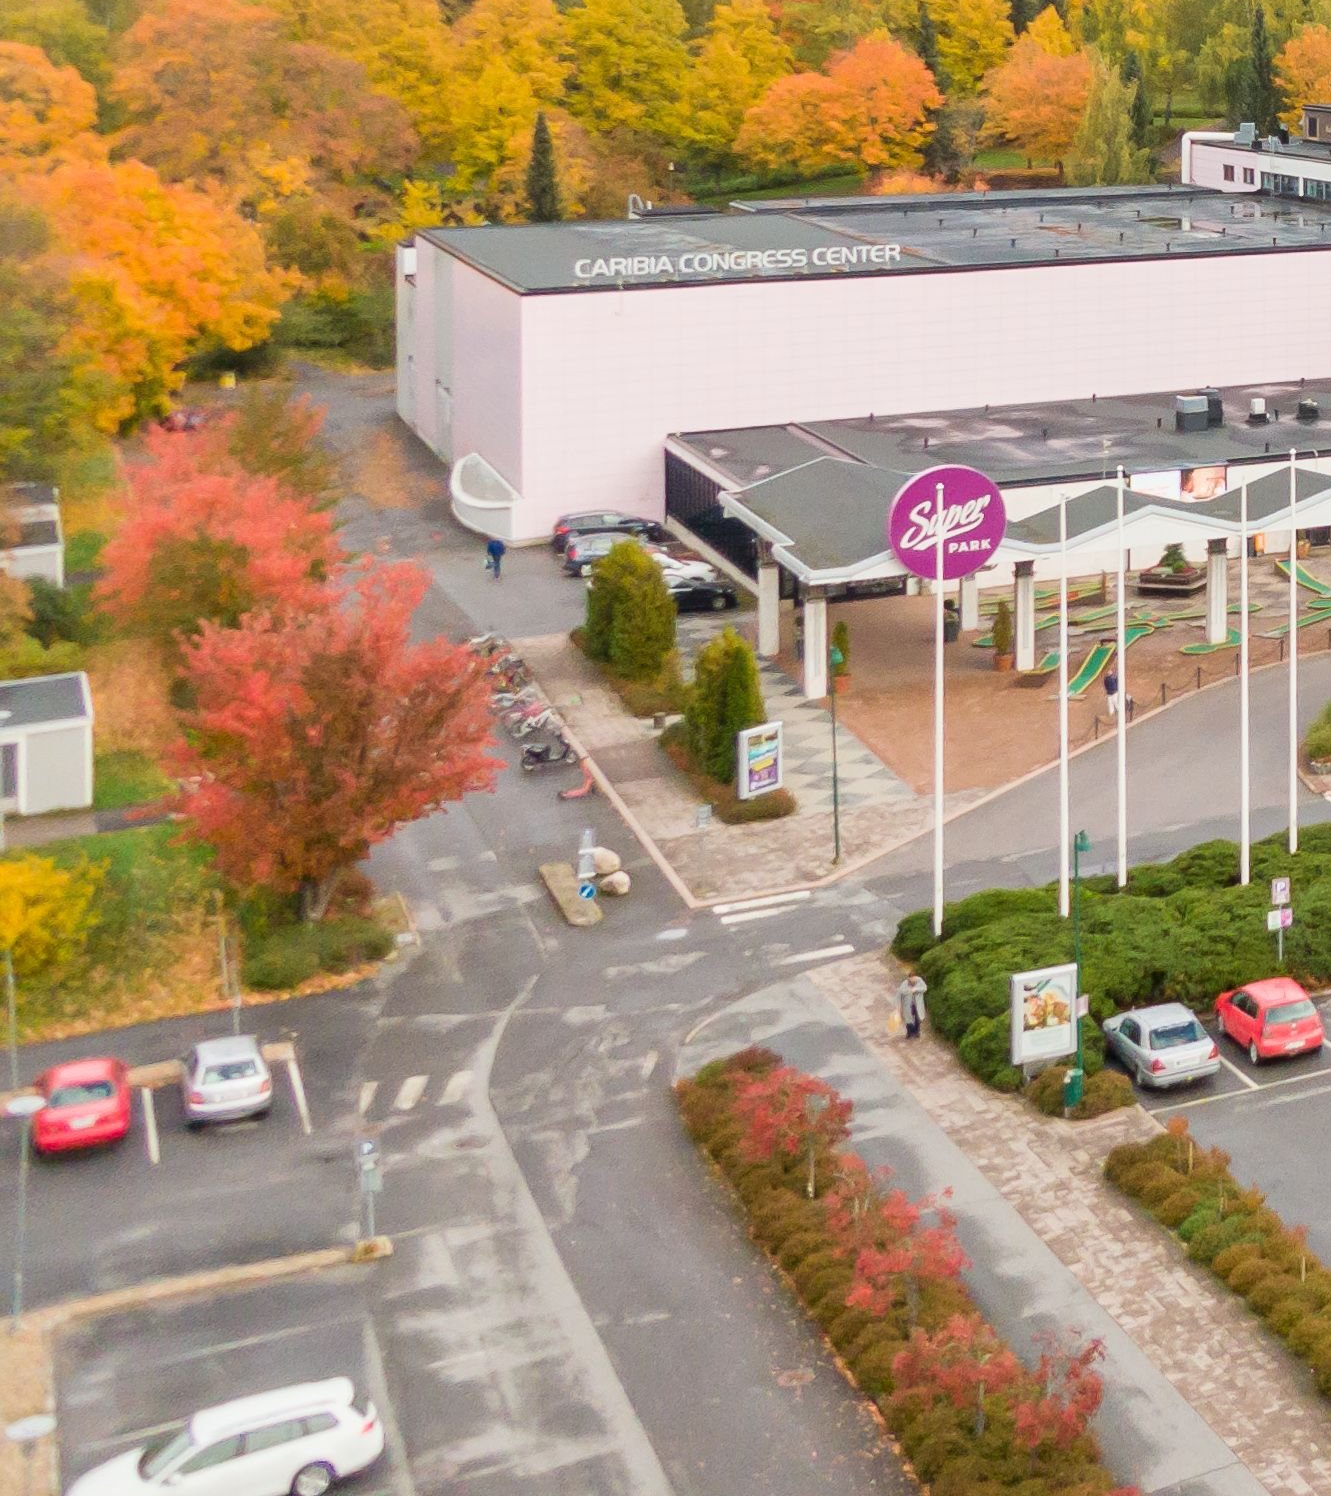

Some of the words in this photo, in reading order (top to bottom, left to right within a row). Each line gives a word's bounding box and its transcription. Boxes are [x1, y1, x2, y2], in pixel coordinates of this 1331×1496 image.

[574, 255, 674, 279] CARIBIA
[678, 248, 807, 273] CONGRESS
[812, 244, 901, 267] CENTER
[948, 538, 991, 554] PARK
